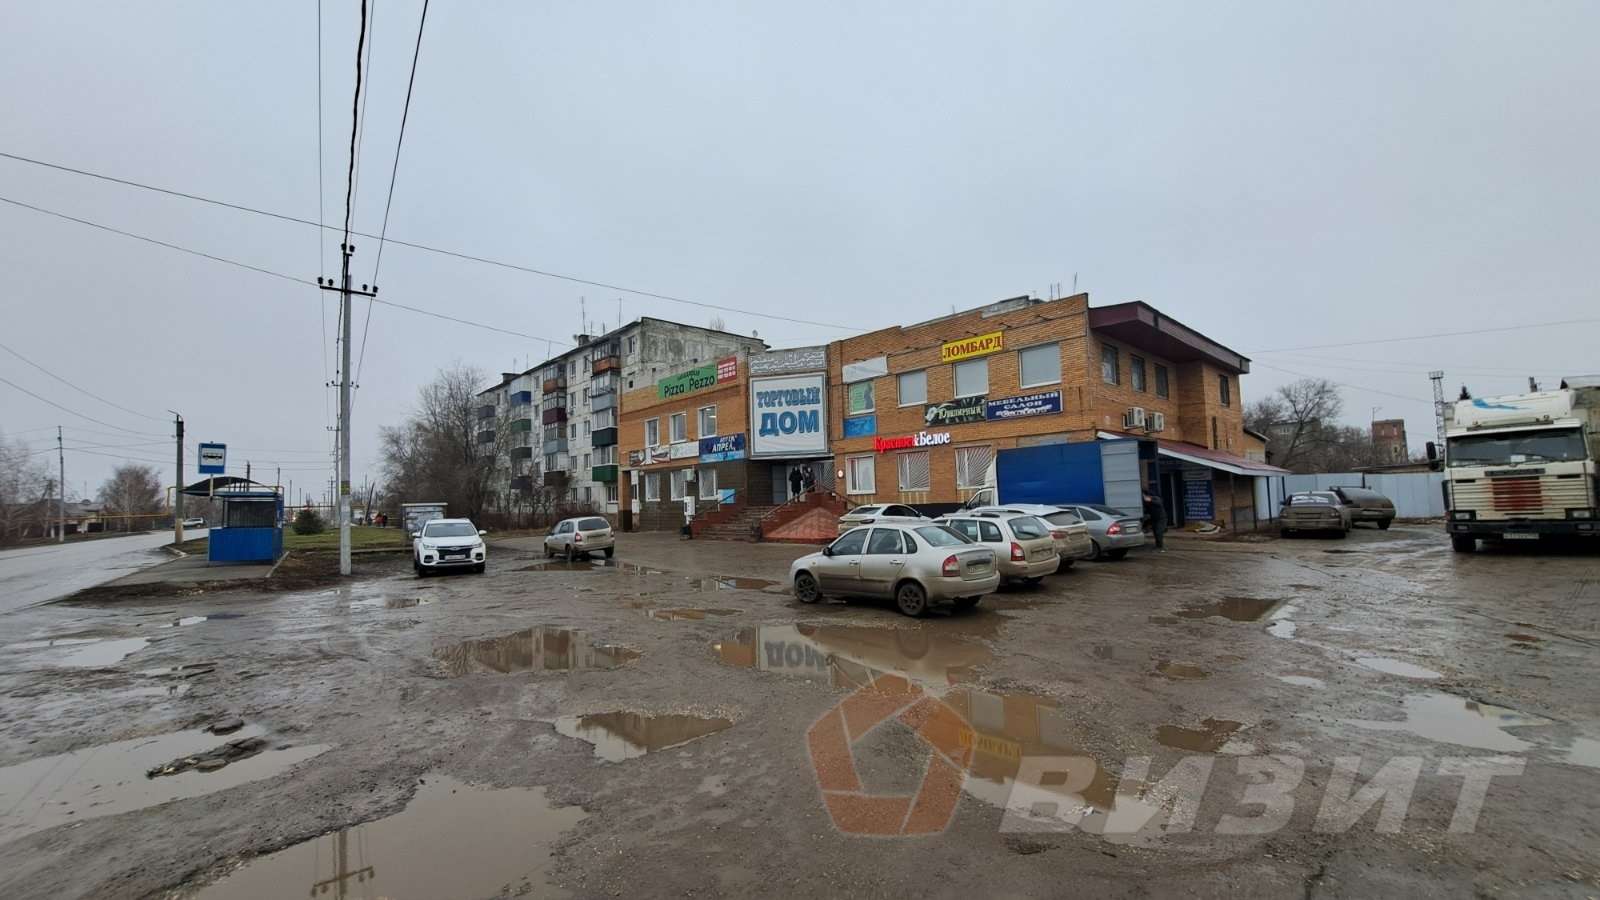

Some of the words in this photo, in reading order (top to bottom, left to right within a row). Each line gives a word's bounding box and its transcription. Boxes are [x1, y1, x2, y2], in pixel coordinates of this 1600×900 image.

[943, 336, 1002, 358] ЛОМБАРД
[664, 384, 685, 398] Pizza
[689, 375, 715, 392] Pezzo
[756, 387, 821, 408] ТОРГОВЫЙ
[988, 392, 1059, 407] МЕБЕЛЬНЫЙ
[1003, 401, 1042, 410] САЛОН
[759, 410, 820, 437] ДОМ
